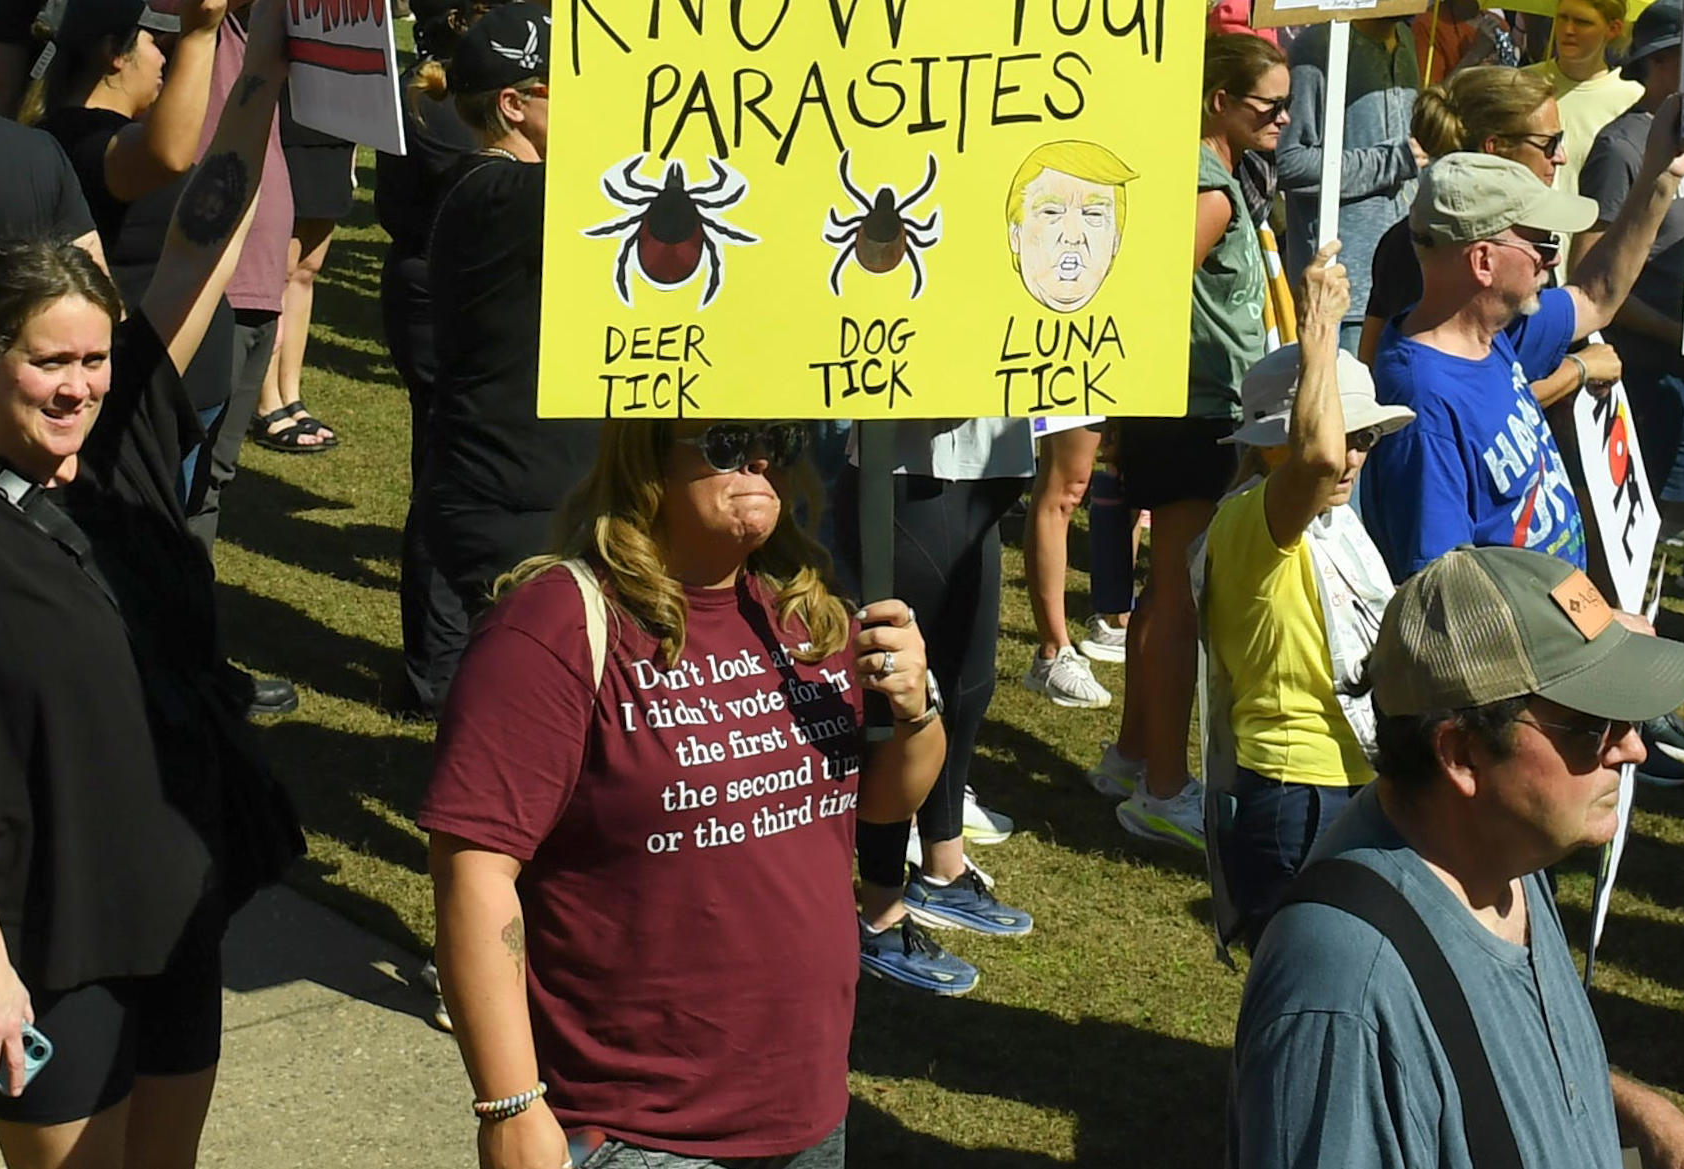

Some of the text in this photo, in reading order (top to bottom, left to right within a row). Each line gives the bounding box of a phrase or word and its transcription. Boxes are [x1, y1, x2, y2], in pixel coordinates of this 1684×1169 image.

[642, 50, 1092, 165] PARASITES
[604, 322, 712, 368] DEER
[839, 316, 917, 357] DOG
[1001, 314, 1126, 361] LUNA
[601, 366, 701, 419] TICK
[809, 358, 913, 410] TICK
[995, 360, 1118, 417] TICK
[708, 647, 767, 685] look
[771, 641, 796, 670] at
[621, 676, 823, 732] I didn't vote for
[675, 728, 788, 768] the first
[661, 749, 860, 813] the second tim
[645, 795, 814, 854] or the third
